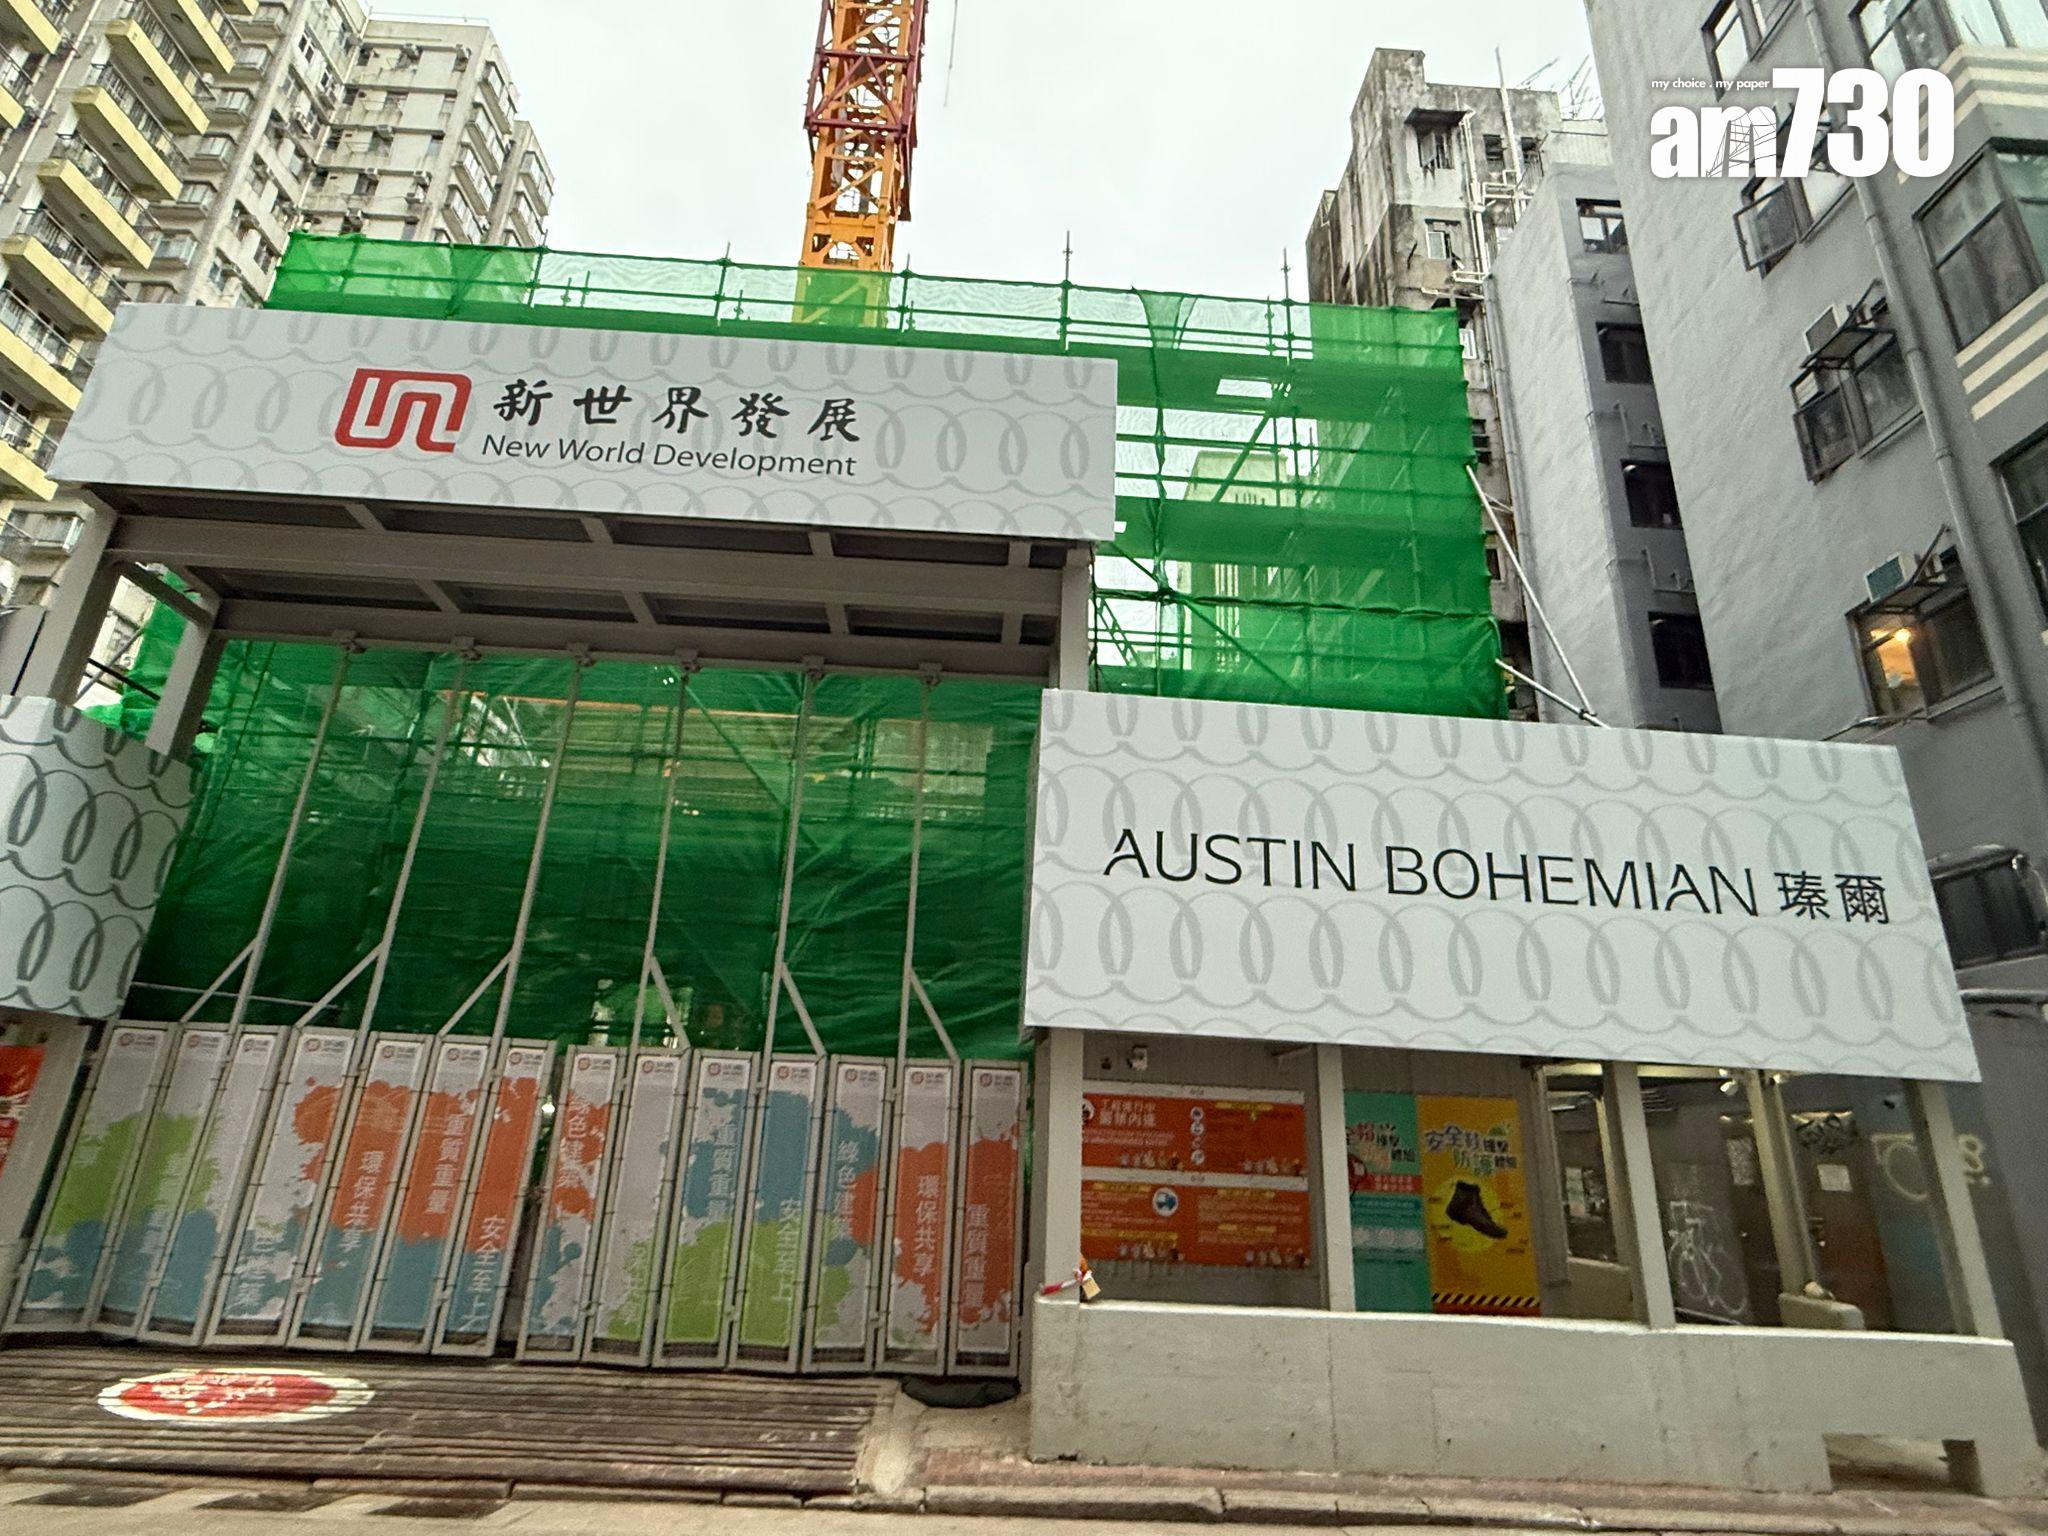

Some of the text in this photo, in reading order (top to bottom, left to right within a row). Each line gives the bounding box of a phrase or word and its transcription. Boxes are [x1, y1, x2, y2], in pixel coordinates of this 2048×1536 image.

[482, 434, 857, 477] New World Development
[494, 379, 860, 441] 新世界發展
[1104, 828, 1889, 925] AUSTIN BOHEMIAN 瑧爾
[460, 1214, 507, 1319] 安全至上
[913, 1174, 940, 1277] 環保共享
